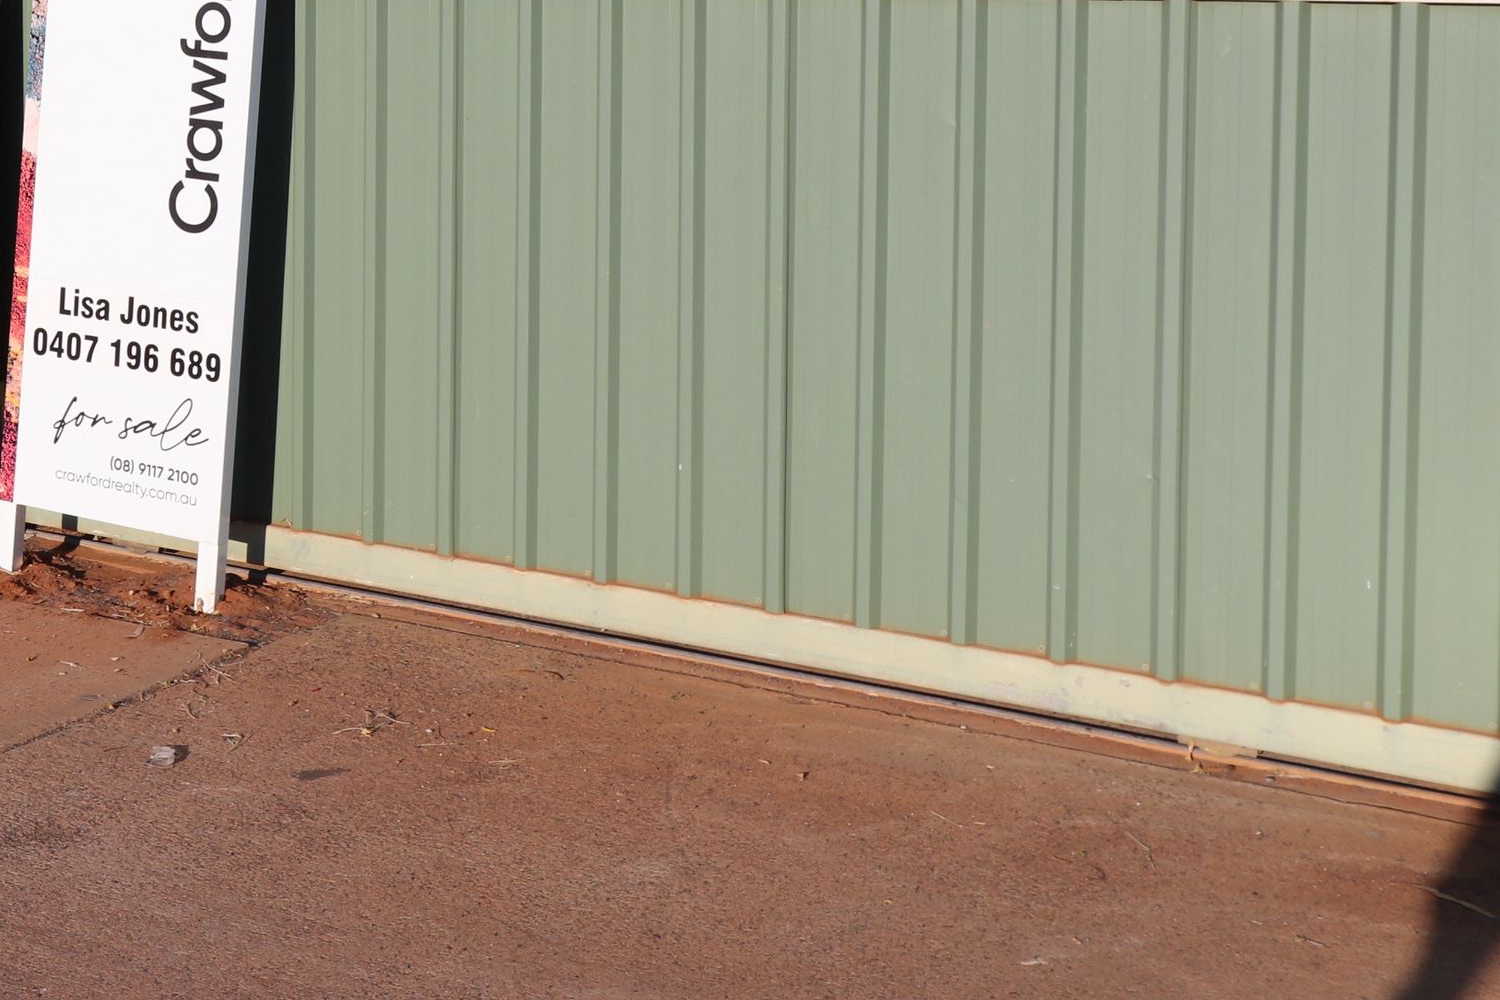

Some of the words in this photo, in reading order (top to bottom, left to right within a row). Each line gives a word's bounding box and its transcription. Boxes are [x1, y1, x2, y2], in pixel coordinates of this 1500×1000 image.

[59, 286, 110, 321] Lisa
[120, 296, 200, 334] Jones
[33, 327, 99, 363] 0407
[110, 339, 159, 373] 196
[170, 348, 221, 382] 689
[53, 396, 112, 444] for
[118, 398, 209, 451] sale
[55, 467, 197, 506] crawfordrealty.com.au
[109, 456, 135, 475] (08)
[138, 463, 163, 479] 9117
[167, 468, 199, 486] 2100
